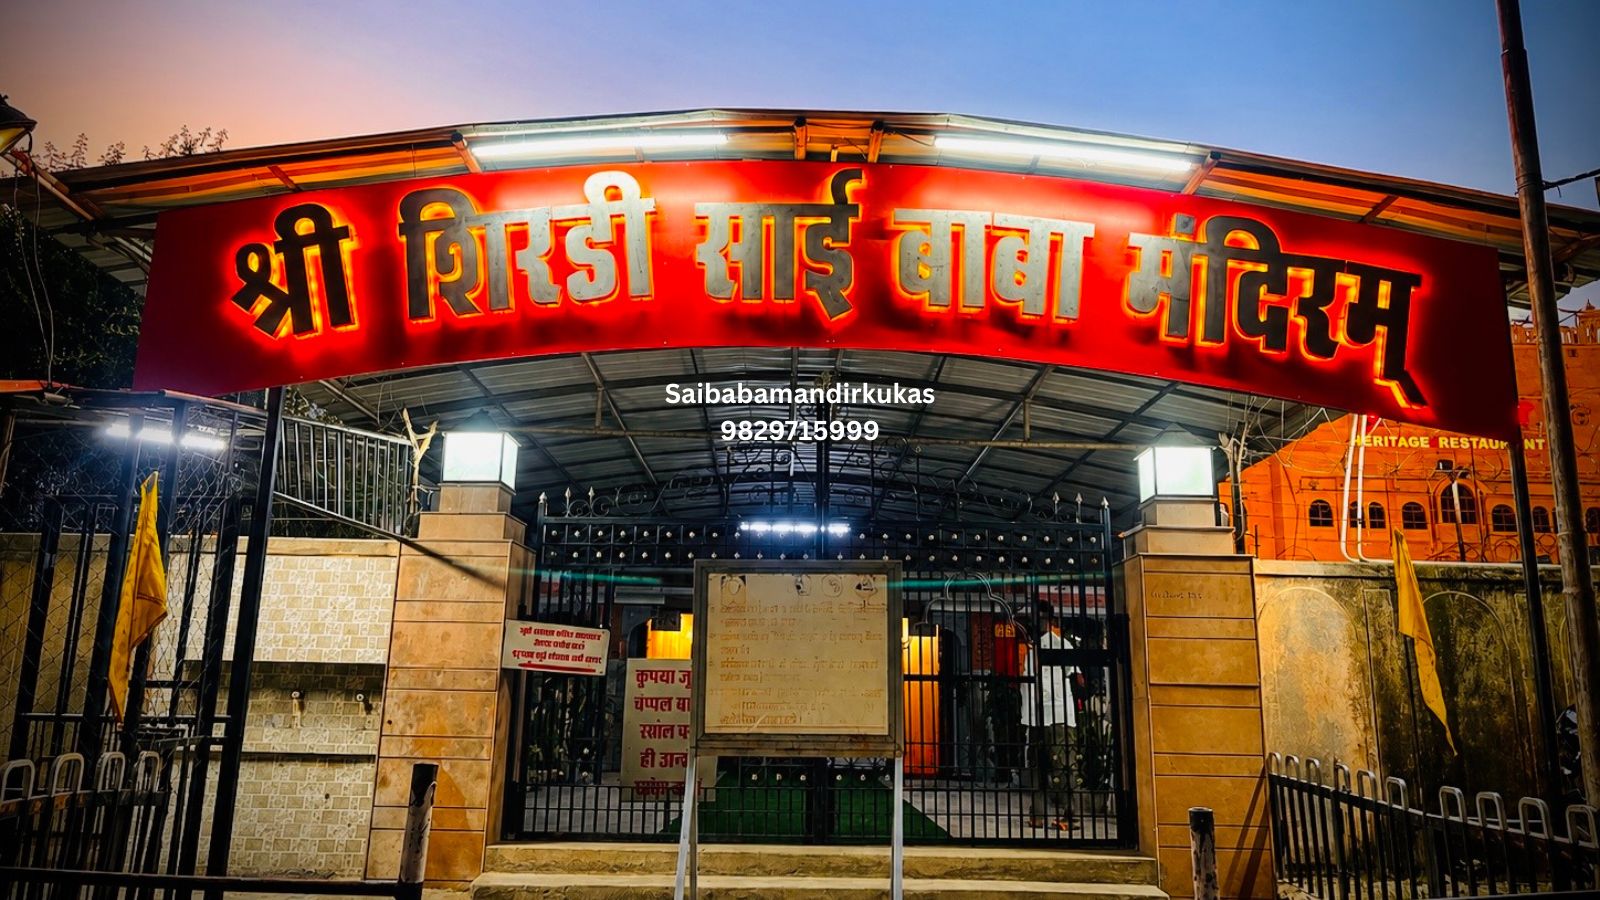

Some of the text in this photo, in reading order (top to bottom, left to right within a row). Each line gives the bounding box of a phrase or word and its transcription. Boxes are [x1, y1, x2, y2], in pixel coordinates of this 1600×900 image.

[232, 202, 355, 339] श्री
[397, 171, 656, 321] शिरडी
[694, 168, 863, 321] साई
[892, 208, 1096, 323] बाबा
[1352, 435, 1546, 450] HERITAGE RESTAURNT
